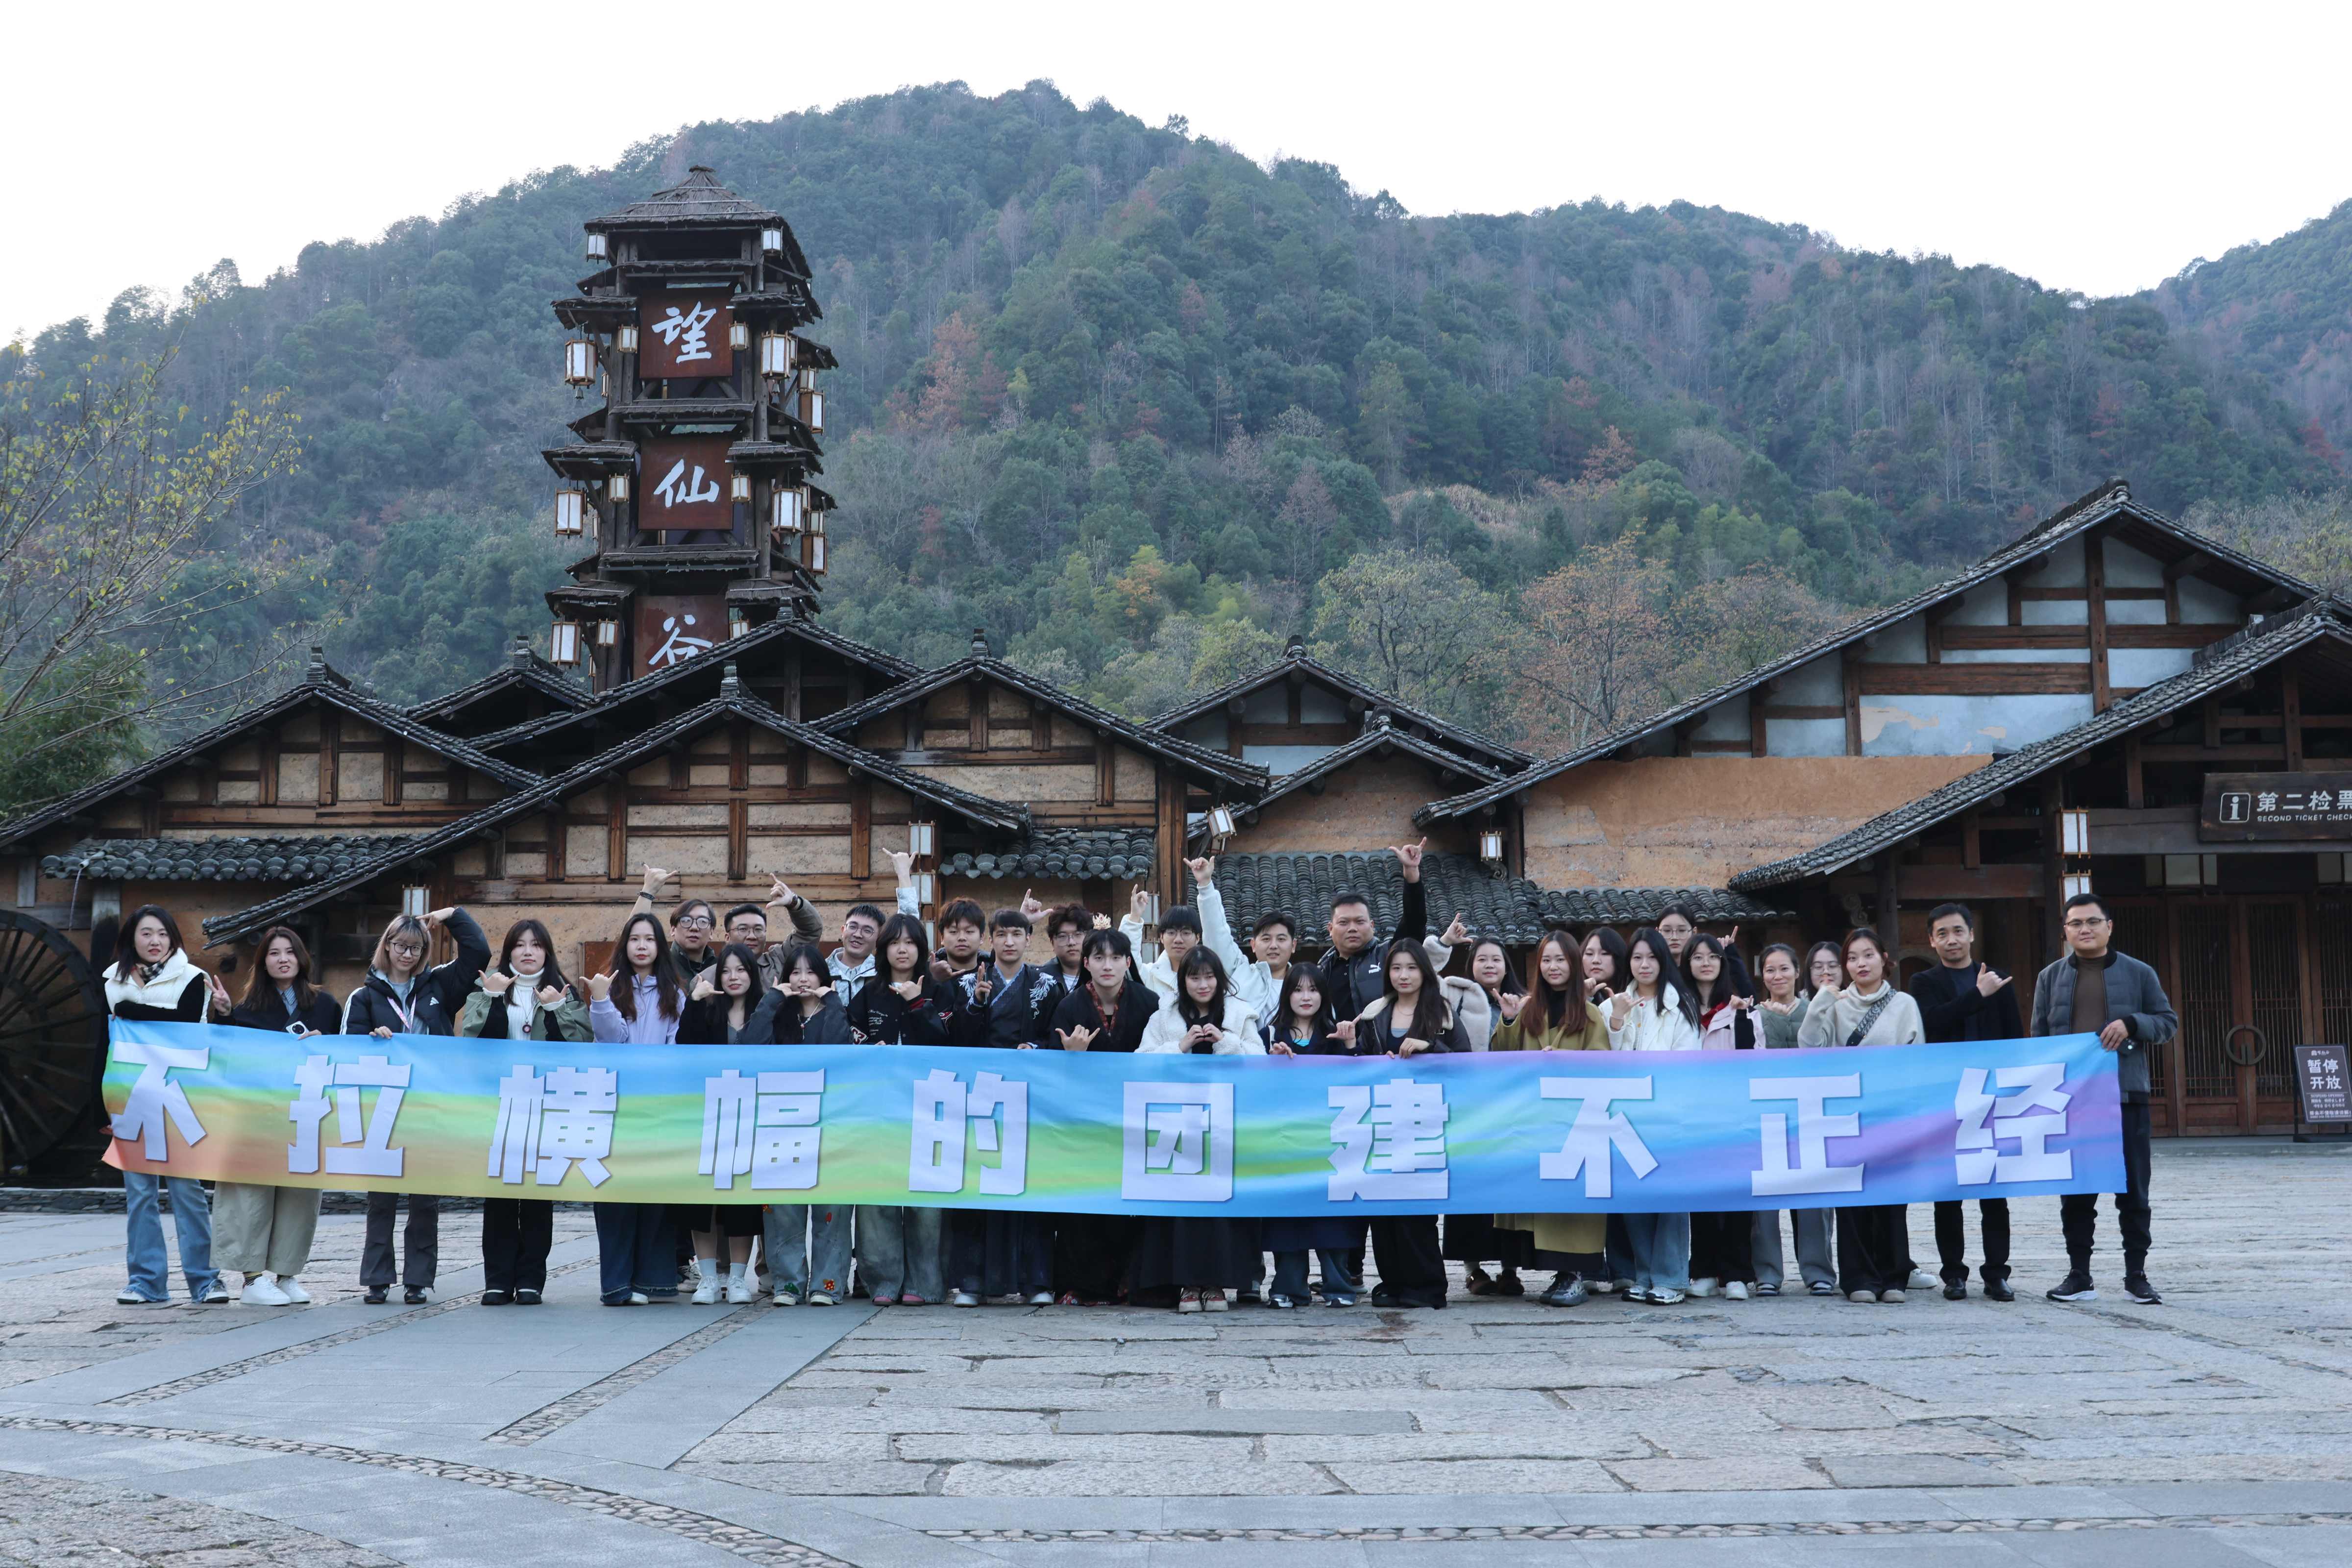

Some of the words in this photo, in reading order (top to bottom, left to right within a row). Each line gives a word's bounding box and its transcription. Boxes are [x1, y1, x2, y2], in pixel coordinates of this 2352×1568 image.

[648, 300, 719, 665] 望仙谷
[2256, 789, 2352, 812] 第二检票
[2307, 1058, 2338, 1073] 暂停
[2310, 1075, 2342, 1089] 开放
[110, 1041, 2073, 1202] 不拉横幅的团建不正经
